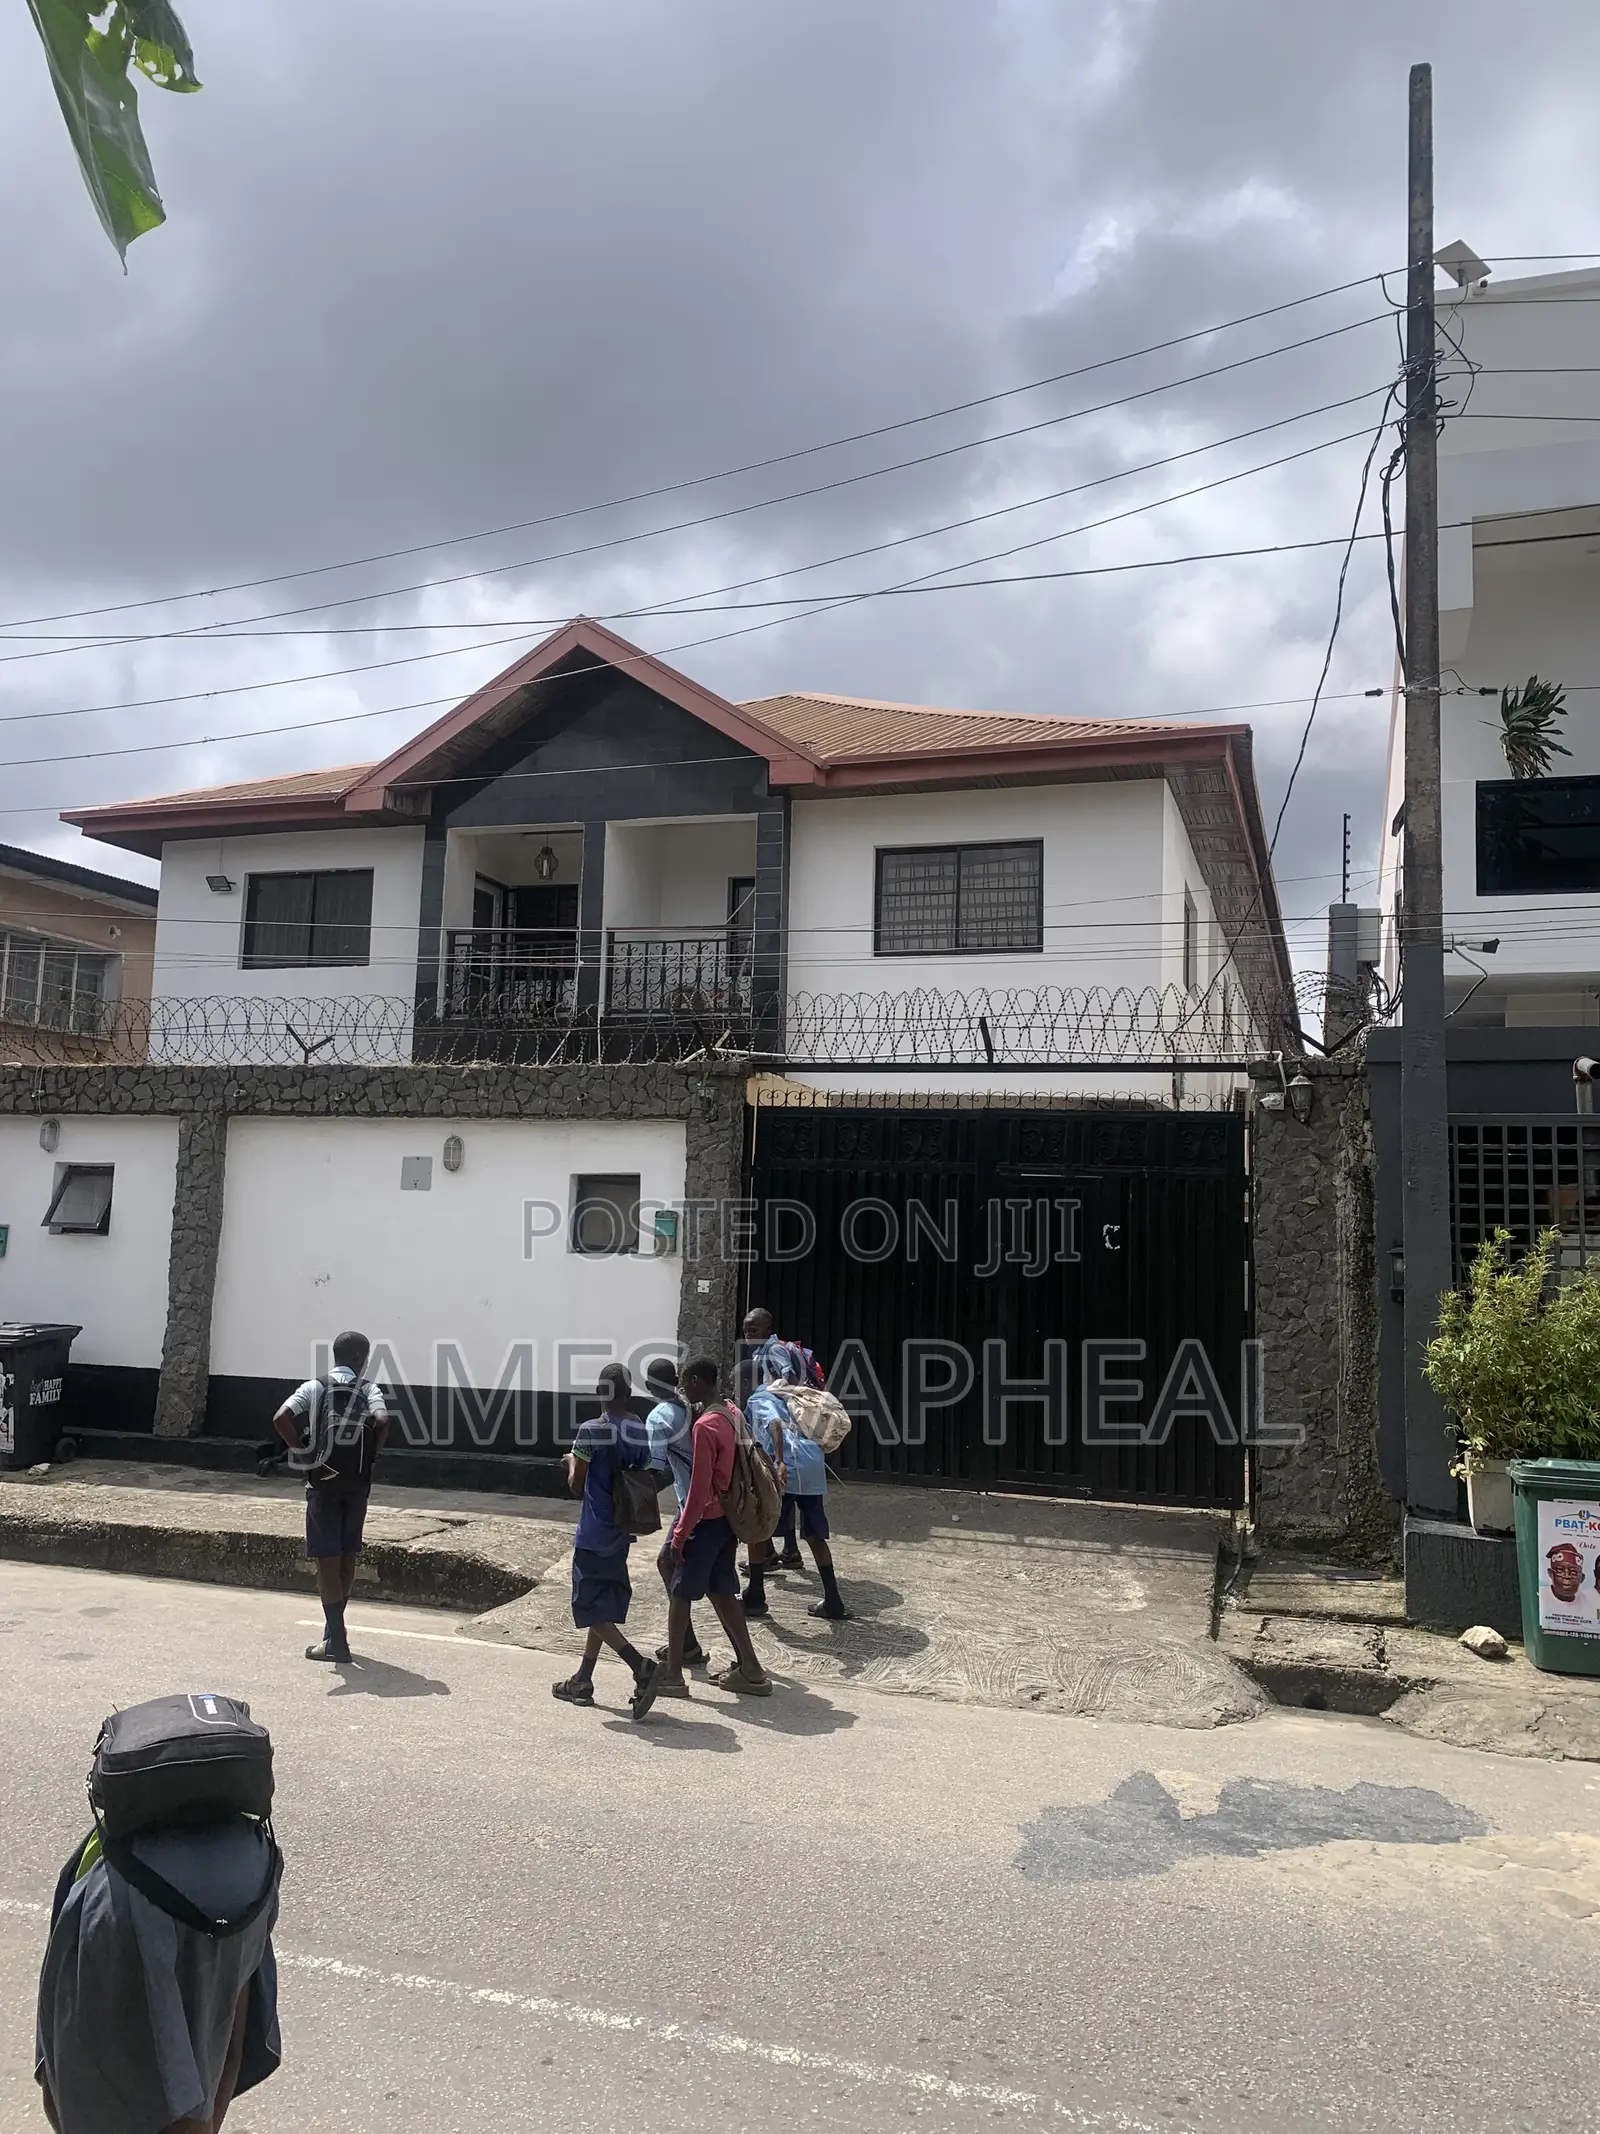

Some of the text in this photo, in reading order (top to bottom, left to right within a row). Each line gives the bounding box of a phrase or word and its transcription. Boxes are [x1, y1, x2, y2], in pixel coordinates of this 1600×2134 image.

[44, 1377, 63, 1391] HAPPY
[29, 1388, 62, 1406] FAMILY
[1554, 1518, 1600, 1531] PBAT-K
